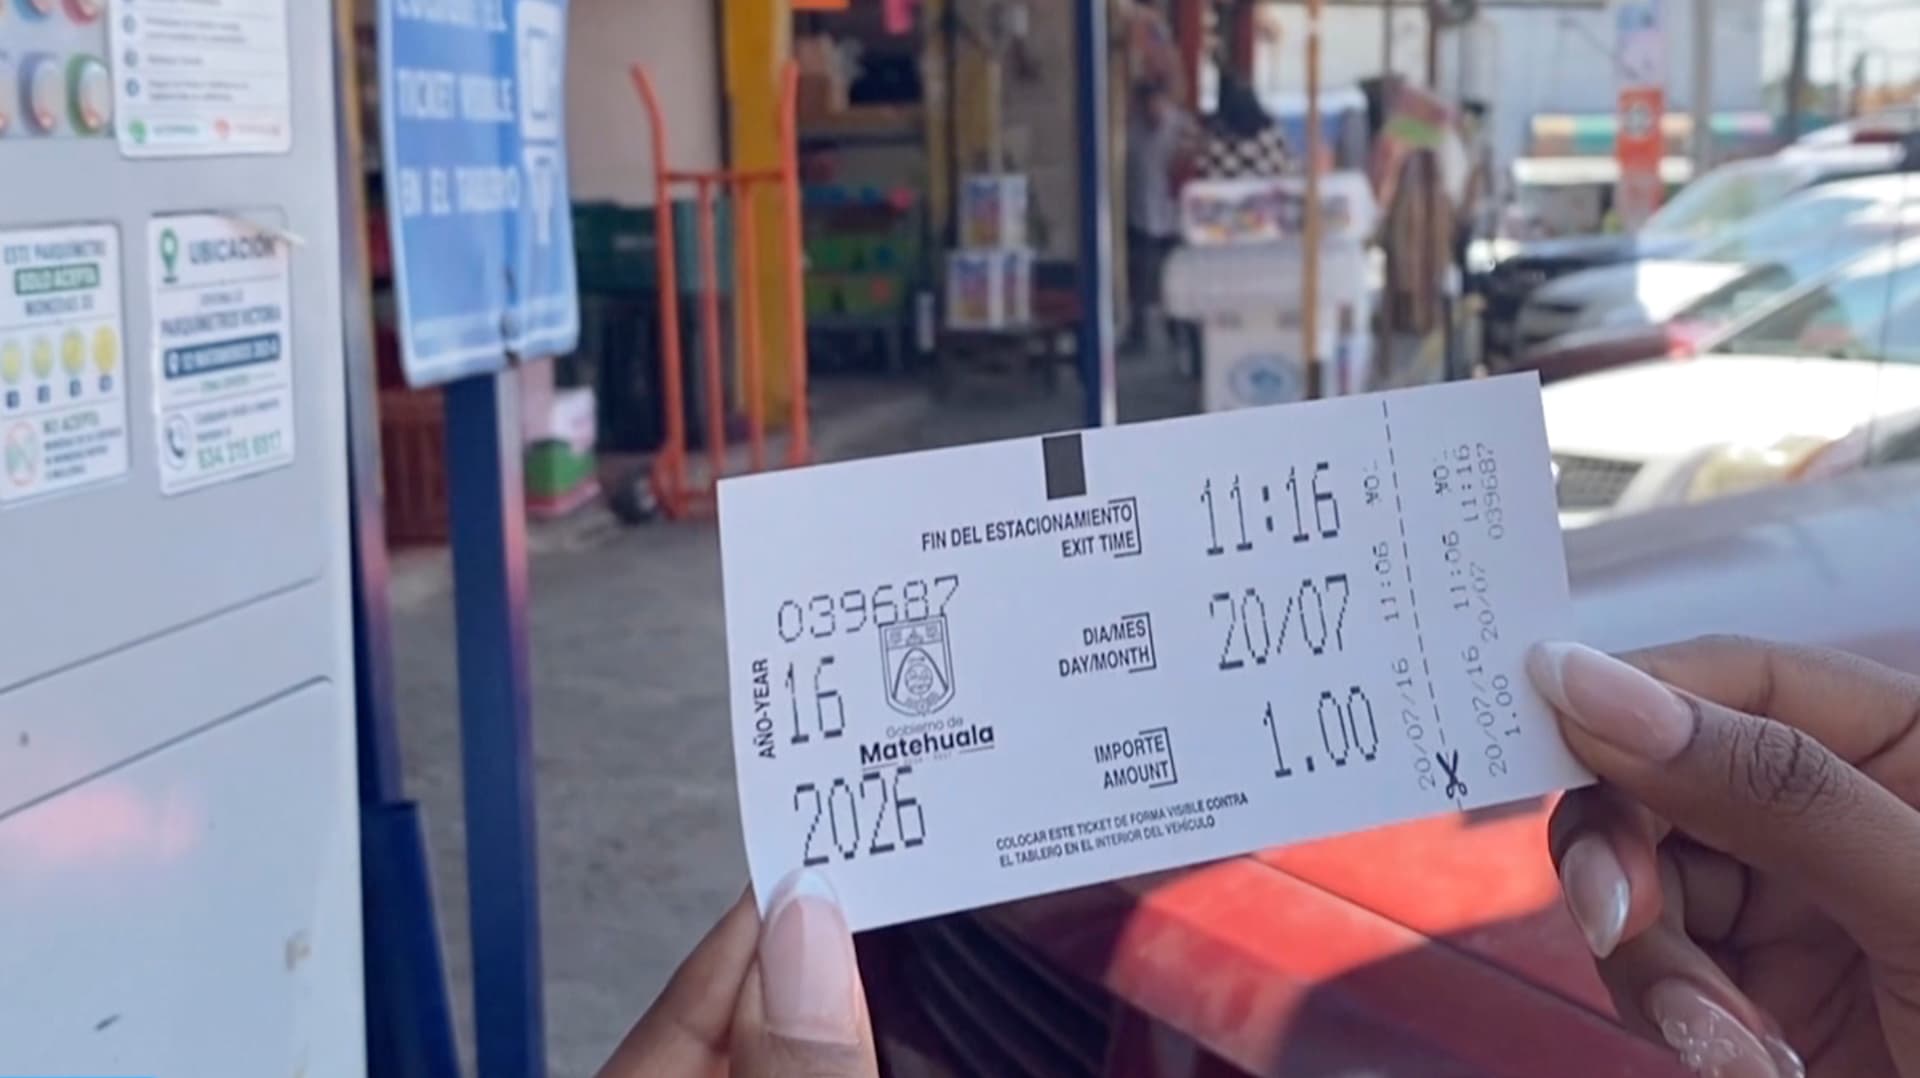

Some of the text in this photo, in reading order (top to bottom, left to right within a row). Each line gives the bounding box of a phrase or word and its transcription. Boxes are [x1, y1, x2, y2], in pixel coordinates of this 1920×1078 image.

[921, 504, 1133, 552] FIN DEL ESTACIONAMIENTO
[1061, 530, 1136, 559] EXIT TIME
[1200, 462, 1341, 556] 11:16
[1372, 541, 1400, 622] 11:06
[1442, 530, 1469, 611] 11:06
[1452, 443, 1521, 737] 1.00 20/07 11:16
[778, 574, 960, 643] 039687
[1083, 619, 1147, 647] DIA/MES
[1209, 573, 1350, 671] 20/07
[785, 655, 846, 744] 16
[1059, 647, 1151, 678] DAY/MONTH
[753, 658, 777, 760] AÑO-YEAR
[859, 724, 995, 766] Matehuala
[886, 716, 964, 739] Gobierno de
[1262, 686, 1378, 778] 1.00
[1392, 657, 1436, 791] 20/07/16
[1462, 645, 1507, 777] 20/07/16
[1094, 734, 1165, 764] IMPORTE
[1104, 761, 1169, 789] AMOUNT
[794, 766, 926, 866] 2026
[996, 792, 1248, 851] COLOCAR ESTE TICKET DE FORMA VISIBLE CONTRA
[1000, 814, 1216, 868] EL TABLERO EN EL INTERIOR DEL VEHÍCULO
